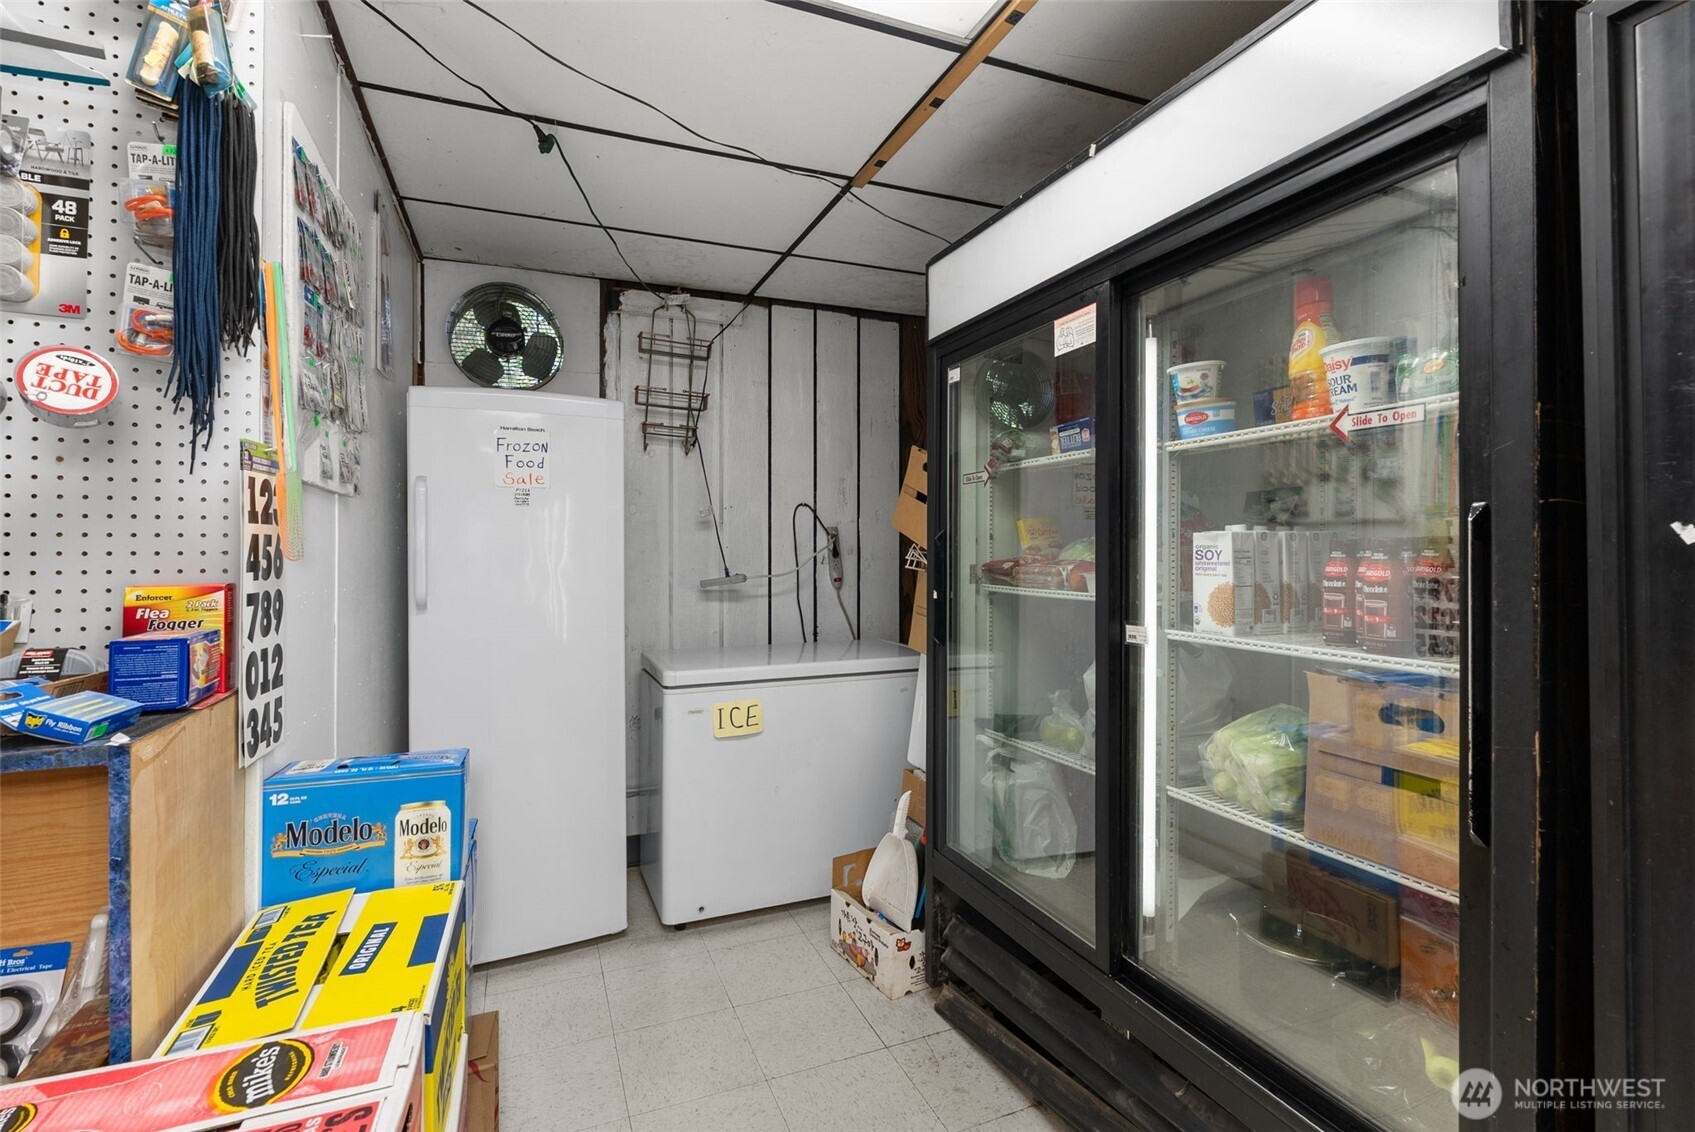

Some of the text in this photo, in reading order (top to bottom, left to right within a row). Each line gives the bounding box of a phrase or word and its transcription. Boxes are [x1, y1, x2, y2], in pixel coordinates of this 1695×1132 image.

[130, 153, 175, 166] TAP-A-LIT
[30, 164, 63, 175] HARDWOOD
[52, 199, 77, 215] 48
[55, 214, 75, 223] PACK
[129, 273, 173, 293] TAP-A-LI
[58, 303, 81, 315] 3M
[35, 362, 102, 388] TAPE
[30, 376, 101, 401] DUCT
[1330, 383, 1357, 396] REAM
[1351, 408, 1417, 427] Slide To Open
[505, 454, 545, 469] Food
[503, 471, 545, 485] Sale
[246, 533, 284, 582] 456
[1195, 549, 1223, 561] SOY
[1325, 565, 1349, 574] ARIGOLD
[1365, 569, 1391, 577] ARIGOLD
[135, 594, 173, 602] Enforcer
[187, 599, 218, 608] 2 Pack
[136, 608, 170, 620] Flea
[246, 588, 284, 643] 789
[147, 619, 204, 631] Fogger
[245, 642, 284, 701] 012
[717, 704, 759, 729] ICE
[45, 719, 57, 728] Fly
[57, 721, 83, 733] Ribbon
[246, 695, 284, 759] 345
[269, 792, 289, 806] 12
[286, 816, 373, 849] Modelo
[399, 816, 448, 837] Modelo
[289, 858, 368, 885] Especial
[348, 926, 390, 971] ORIGINAL
[7, 958, 25, 967] Bros
[255, 909, 338, 1009] TWISTED TEA
[7, 965, 36, 974] Electrical
[241, 973, 257, 992] HARD
[250, 956, 267, 972] ICED
[242, 1046, 280, 1104] mike's
